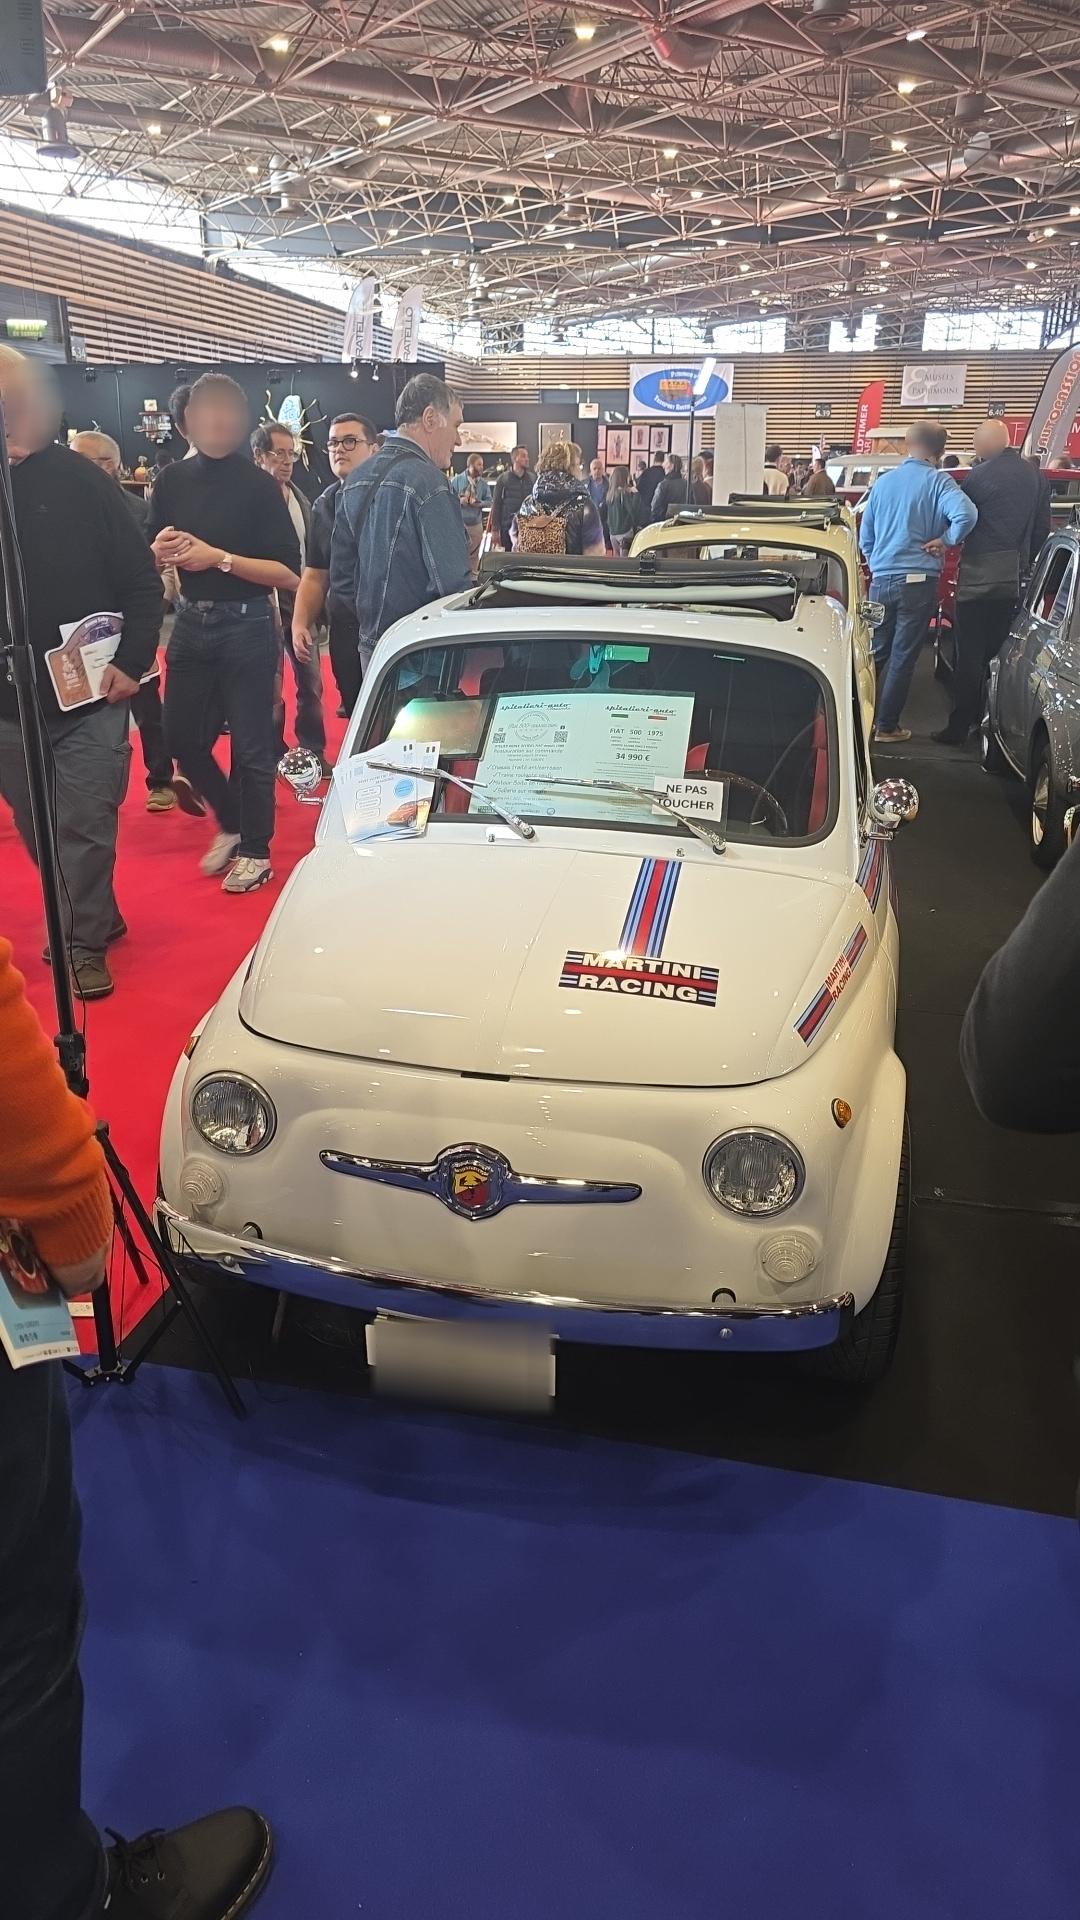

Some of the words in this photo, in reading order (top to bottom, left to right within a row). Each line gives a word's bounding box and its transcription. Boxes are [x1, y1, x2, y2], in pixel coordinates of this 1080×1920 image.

[616, 752, 626, 760] 34
[627, 753, 643, 761] 990
[645, 754, 651, 762] €
[665, 784, 682, 794] NE
[684, 784, 708, 796] PAS
[657, 797, 714, 811] TOUCHER
[581, 953, 702, 980] MARTINI
[824, 954, 847, 989] MARTINI
[578, 974, 698, 1002] RACING
[831, 967, 852, 1002] RACING
